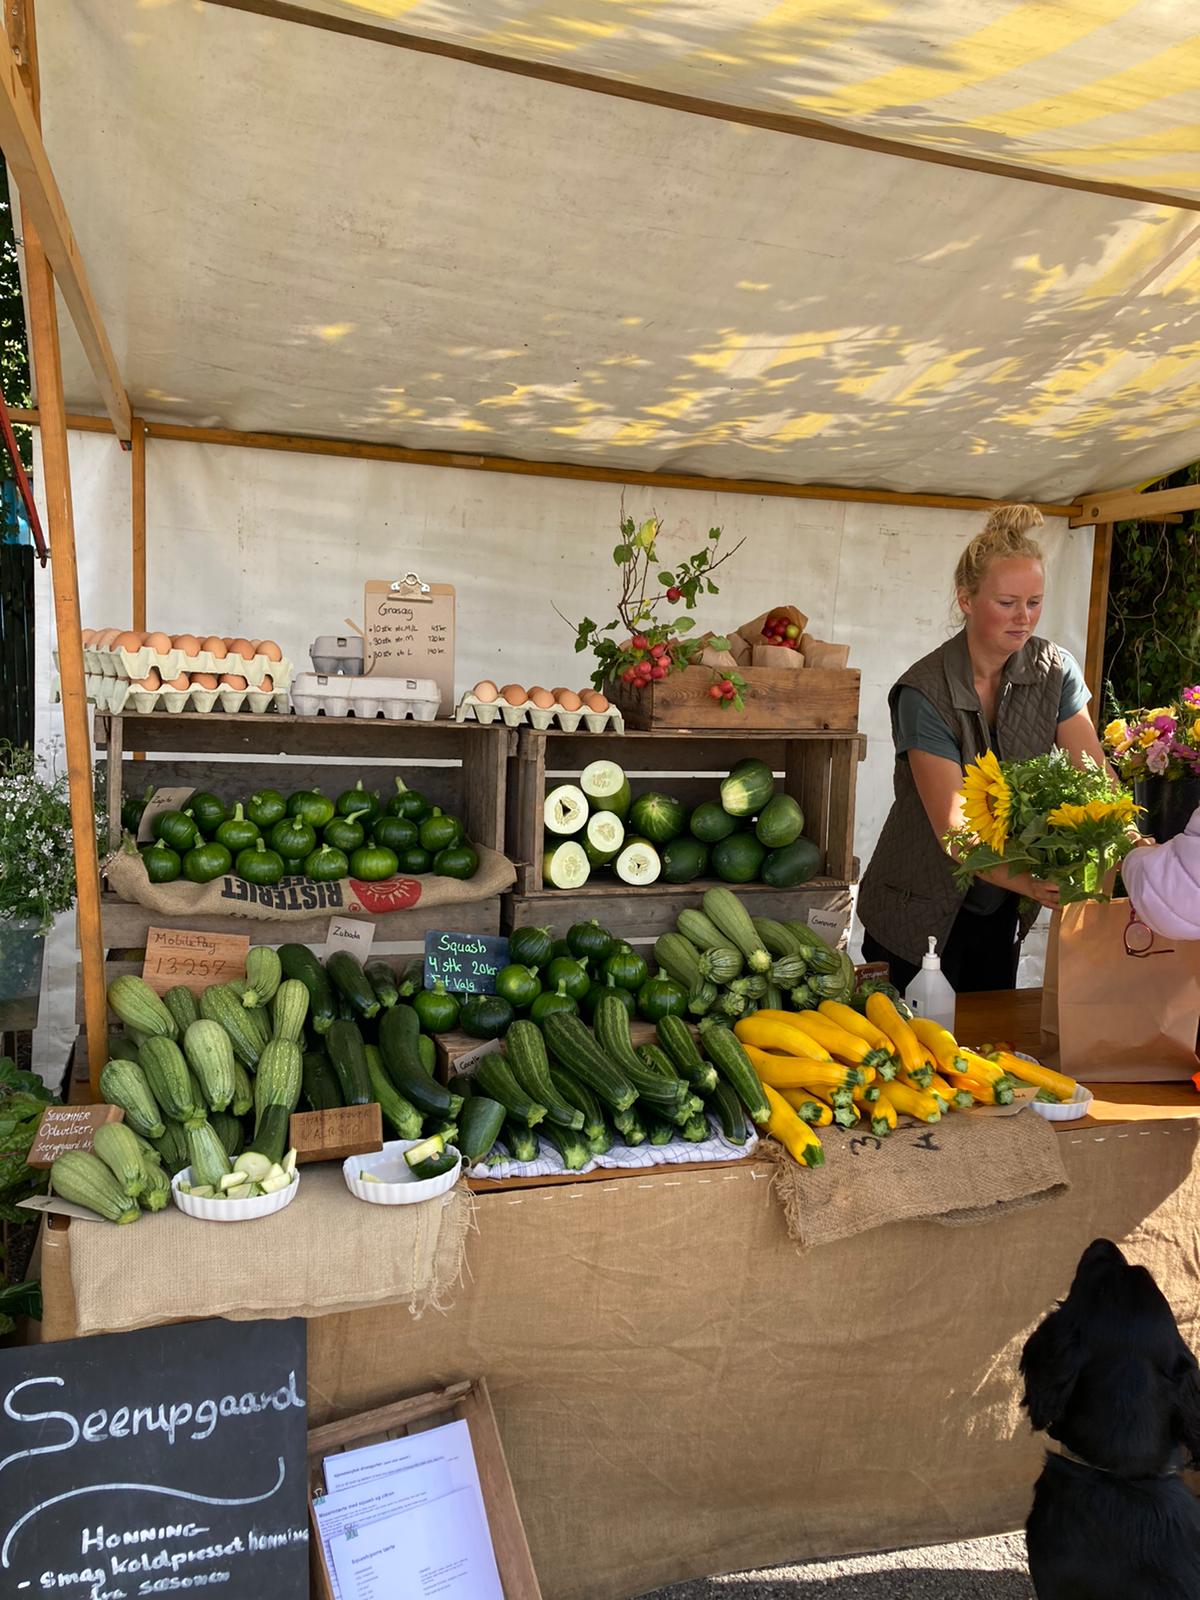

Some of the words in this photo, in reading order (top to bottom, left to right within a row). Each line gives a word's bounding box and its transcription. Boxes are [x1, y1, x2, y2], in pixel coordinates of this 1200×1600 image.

[221, 877, 343, 910] RISTERIET
[437, 934, 487, 956] Squash
[428, 956, 438, 972] 4
[442, 957, 462, 973] stk
[453, 977, 475, 992] Valg
[0, 1370, 305, 1470] Seerupgaard
[110, 1536, 245, 1575] koldpresset
